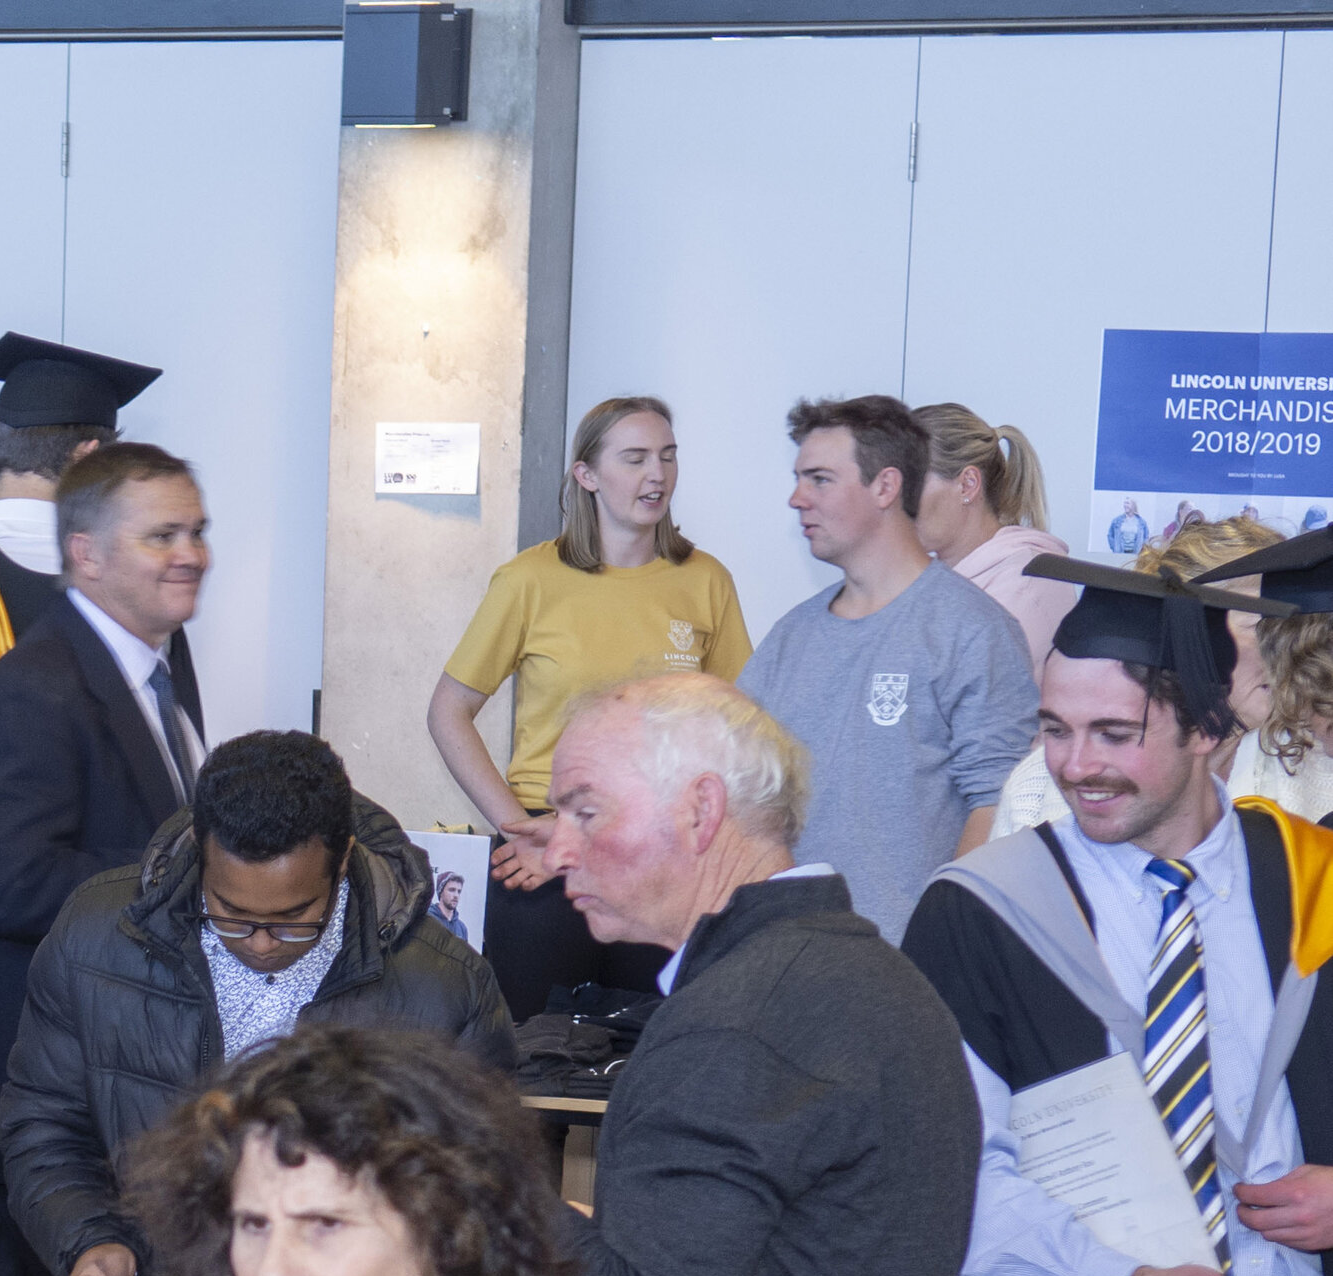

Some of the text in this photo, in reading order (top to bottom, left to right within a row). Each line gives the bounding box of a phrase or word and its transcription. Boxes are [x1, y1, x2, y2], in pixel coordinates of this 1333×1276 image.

[1171, 374, 1333, 391] LINCOLN UNIVERSI
[1165, 397, 1333, 423] MERCHANDIS
[1190, 430, 1321, 456] 2018/2019
[664, 652, 701, 662] LINCOLN
[1009, 1112, 1043, 1131] COLN
